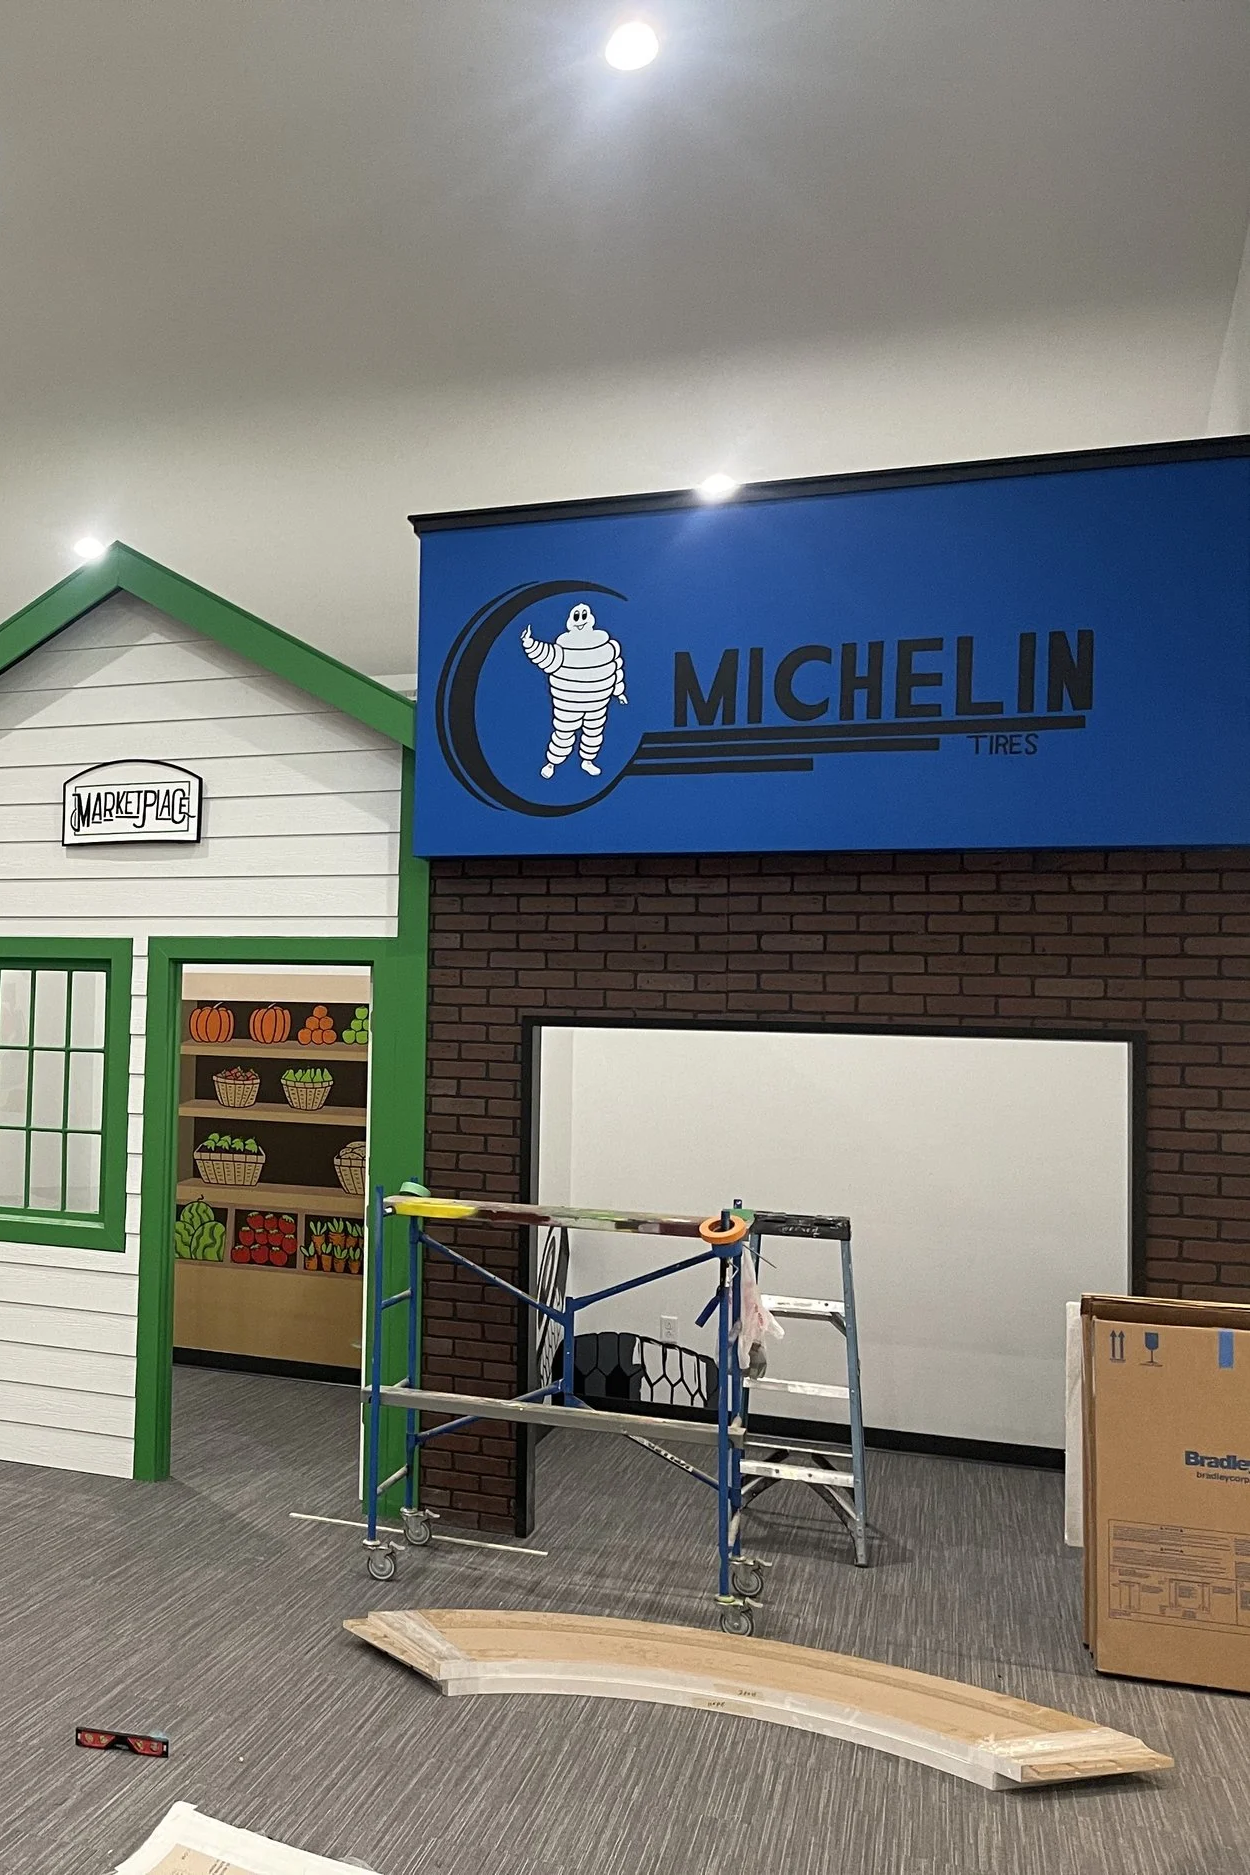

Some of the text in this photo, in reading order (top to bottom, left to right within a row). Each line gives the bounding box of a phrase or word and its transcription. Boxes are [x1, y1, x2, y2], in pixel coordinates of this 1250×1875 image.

[673, 629, 1094, 728] MICHELIN
[966, 733, 1039, 755] TIRES
[70, 788, 197, 832] MARKETPLACE
[1184, 1450, 1250, 1473] Bradle
